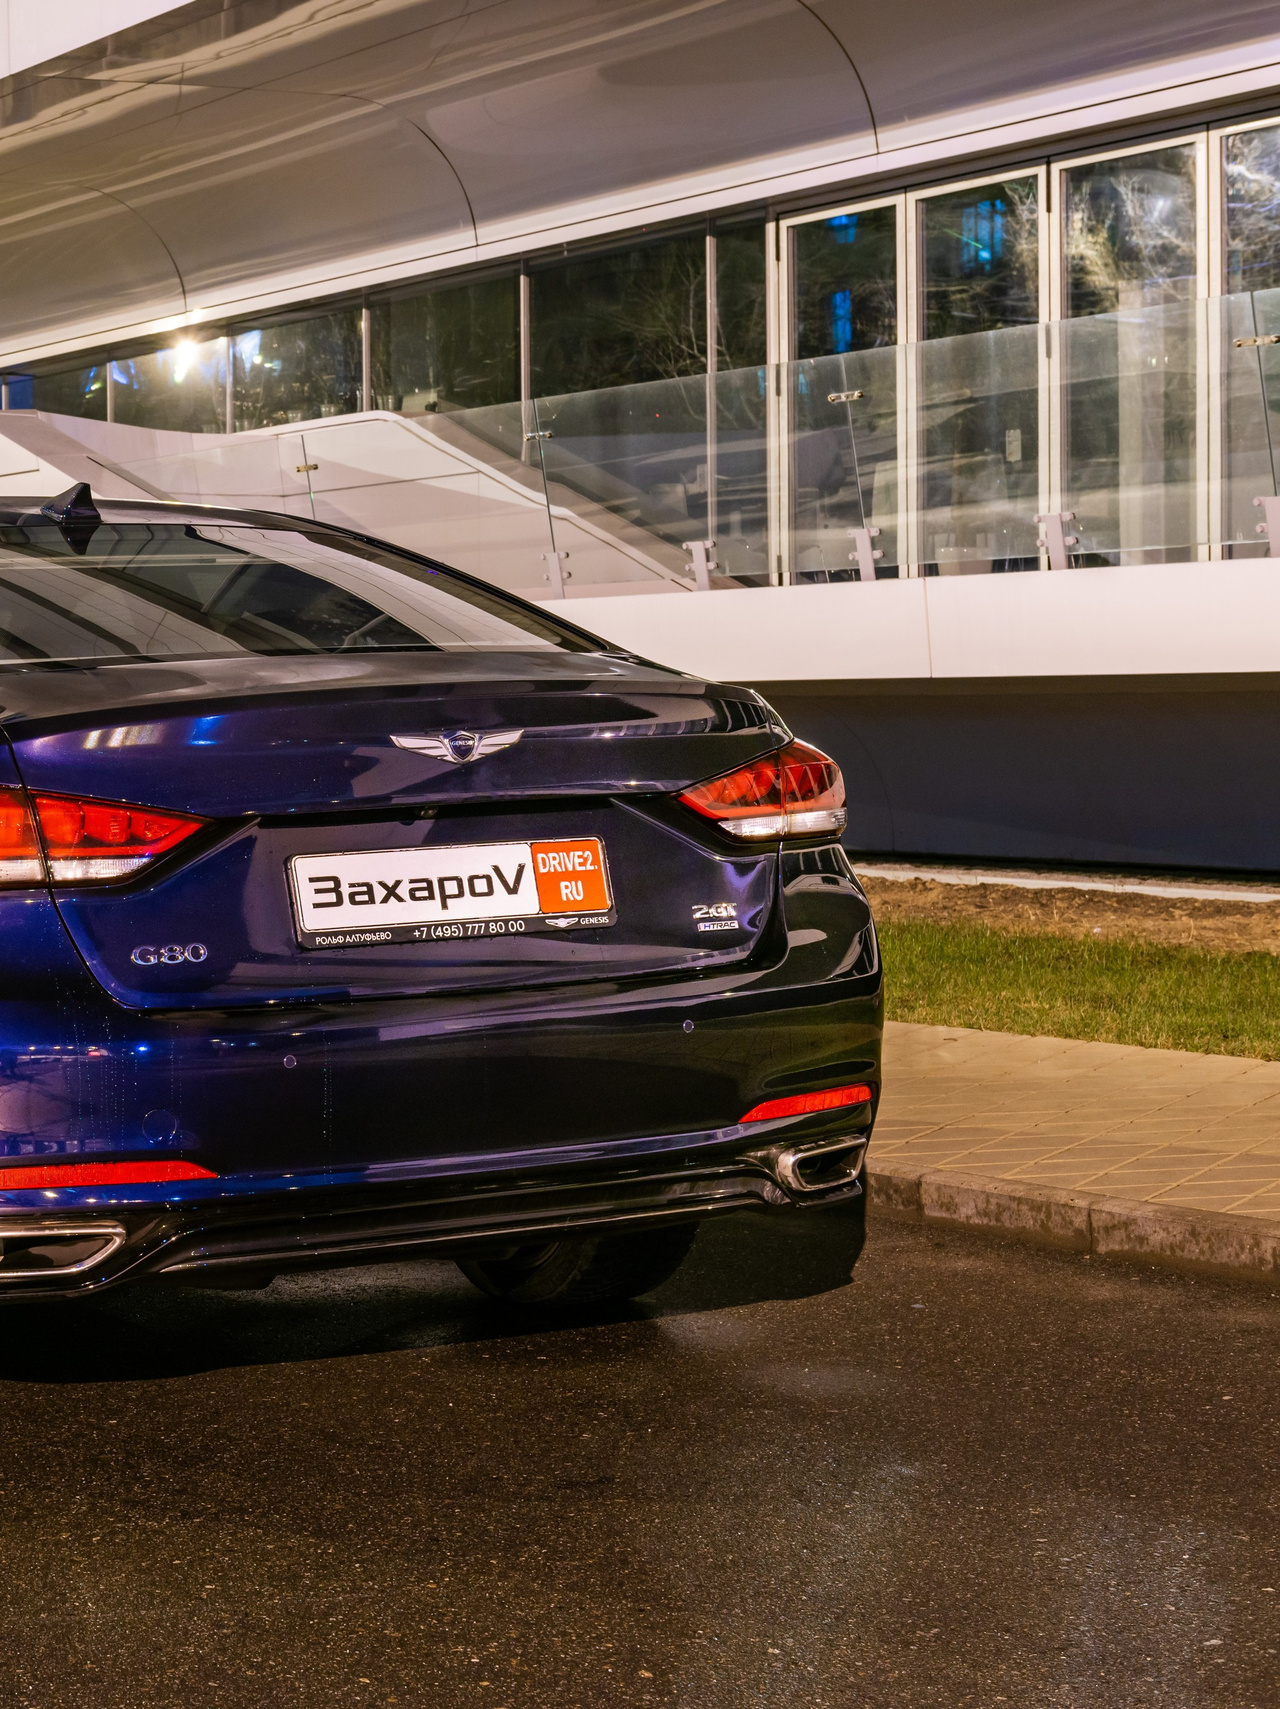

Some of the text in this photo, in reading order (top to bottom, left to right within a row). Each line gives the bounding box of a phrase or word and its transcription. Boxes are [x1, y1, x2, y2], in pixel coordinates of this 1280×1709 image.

[560, 880, 584, 901] RU
[580, 916, 609, 925] GENESIS
[703, 921, 736, 930] HTRAC
[413, 920, 525, 939] +7 (495) 777 80 00
[315, 931, 392, 945] РОЛЬФ АЛТУФЬЕВО
[131, 943, 208, 965] G80
